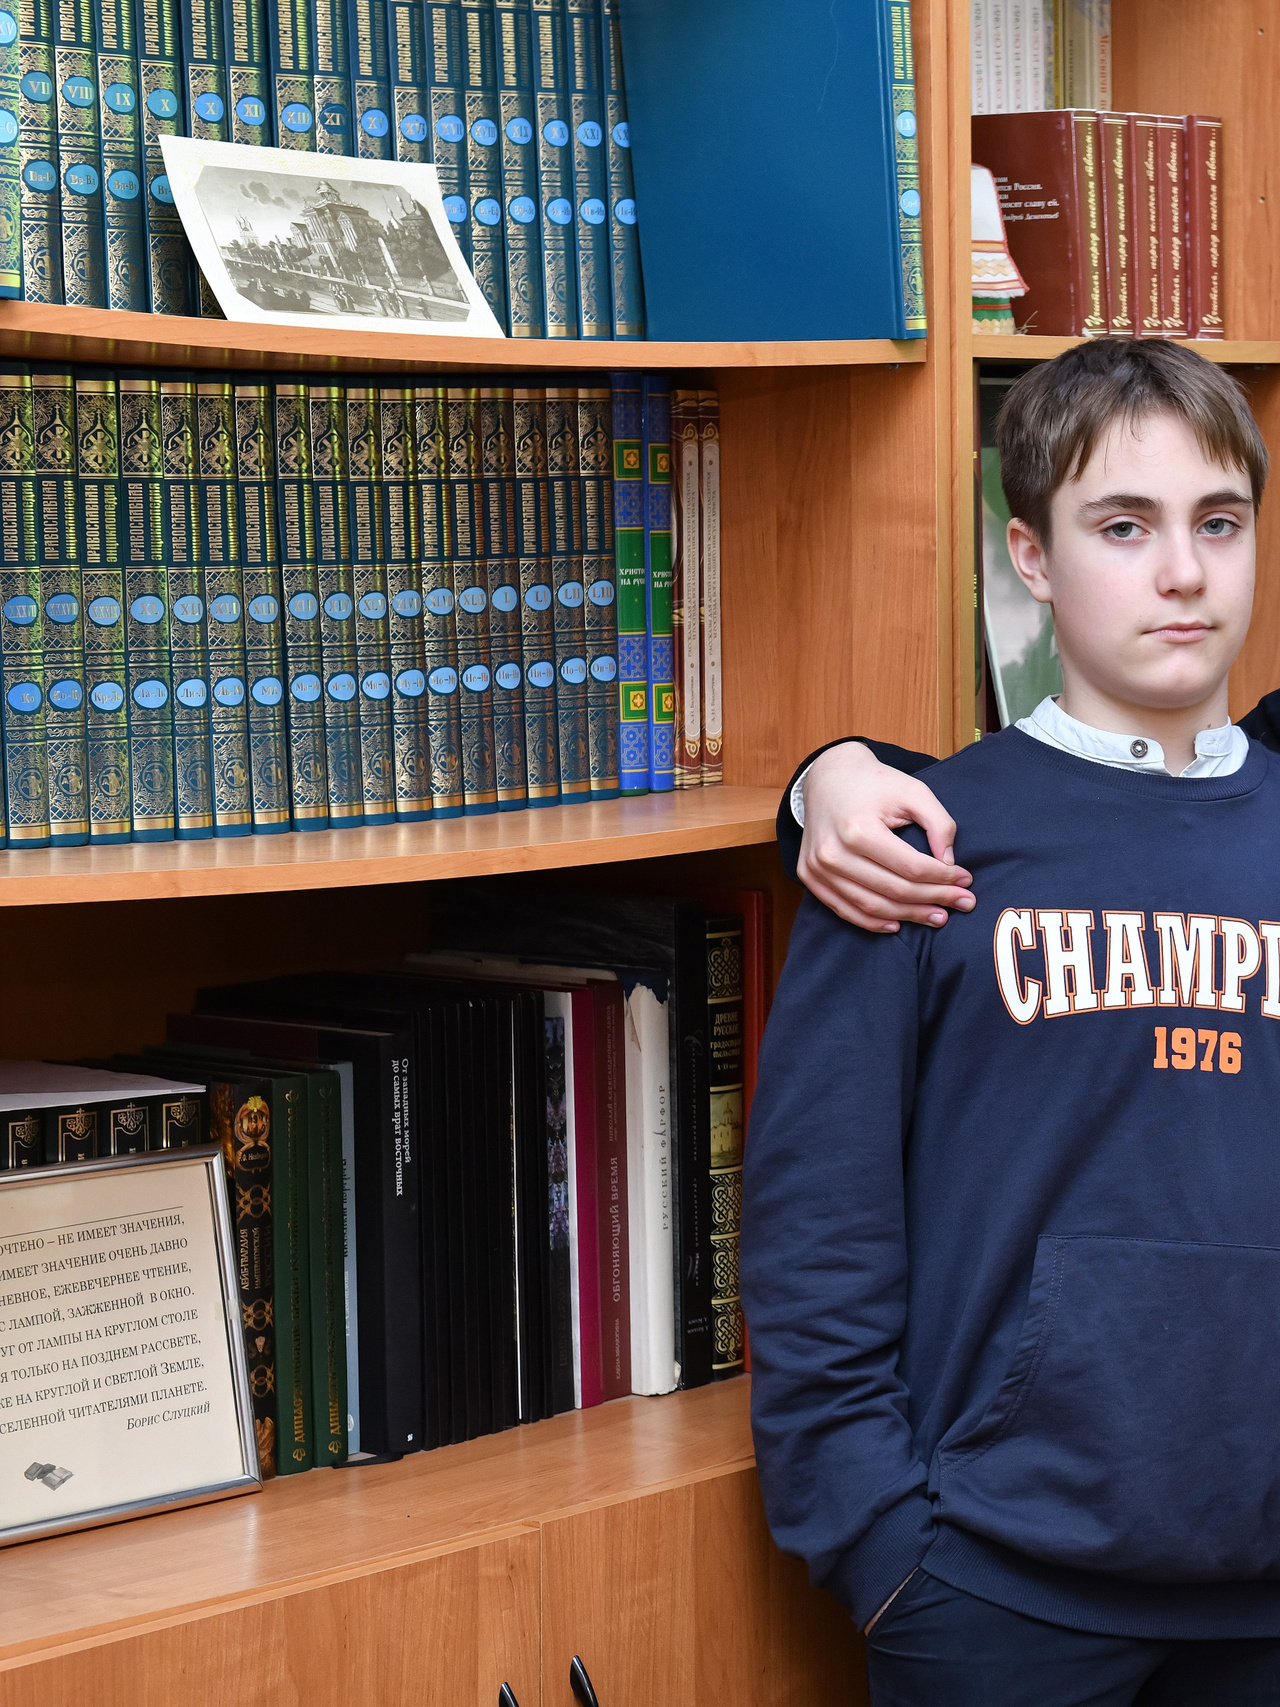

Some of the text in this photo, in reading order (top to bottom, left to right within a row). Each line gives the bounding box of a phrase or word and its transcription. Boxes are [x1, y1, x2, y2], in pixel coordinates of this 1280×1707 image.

[316, 0, 334, 72] ПРАВОСЛАВНА
[396, 6, 413, 83] ПРАВОСЛАВНАЯ
[432, 8, 449, 83] ПРАВОСЛАВНАЯ
[466, 12, 483, 87] ПРАВОСЛАВНАЯ
[501, 12, 518, 87] ПРАВОСЛАВНАЯ
[538, 15, 555, 89] ПРАВОСЛАВНАЯ
[29, 80, 50, 95] VII
[67, 84, 93, 100] VIII
[115, 92, 131, 106] IX
[160, 98, 171, 112] X
[205, 102, 219, 115] XI
[367, 116, 384, 129] XV
[404, 122, 425, 136] XVI
[441, 122, 463, 136] XVII
[512, 125, 530, 139] XIX
[551, 126, 566, 140] XX
[1, 481, 19, 562] ПРАВОСЛАВНАЯ
[42, 480, 60, 560] ПРАВОСЛАВНАЯ
[84, 484, 101, 563] ПРАВОСЛАВНАЯ
[128, 482, 145, 561] ПРАВОСЛАВНАЯ
[169, 484, 188, 562] ПРАВОСЛАВНАЯ
[206, 484, 224, 561] ПРАВОСЛАВНАЯ
[244, 486, 262, 563] ПРАВОСЛАВНАЯ
[284, 484, 301, 560] ПРАВОСЛАВНАЯ
[319, 485, 336, 561] ПРАВОСЛАВНАЯ
[355, 486, 372, 561] ПРАВОСЛАВНАЯ
[388, 485, 406, 560] ПРАВОСЛАВНАЯ
[422, 484, 439, 558] ПРАВОСЛАВНАЯ
[455, 483, 472, 557] ПРАВОСЛАВНАЯ
[488, 482, 504, 555] ПРАВОСЛАВНАЯ
[521, 482, 537, 554] ПРАВОСЛАВНАЯ
[554, 481, 569, 552] ПРАВОСЛАВНАЯ
[585, 480, 600, 550] ПРАВОСЛАВНАЯ
[535, 590, 549, 603] LI
[592, 586, 613, 599] LIII
[620, 578, 631, 586] НА
[140, 603, 158, 616] XL
[391, 1060, 399, 1073] до
[401, 1058, 409, 1073] От
[1153, 1026, 1242, 1074] 1976
[392, 1111, 401, 1135] врат
[403, 1129, 412, 1163] морей
[395, 1138, 403, 1196] восточных
[652, 1085, 669, 1230] РУССКИЙ ФАРФОР
[58, 1233, 74, 1246] НЕ
[77, 1226, 117, 1242] ИМЕЕТ
[119, 1214, 185, 1234] ЗНАЧЕНИЯ,
[609, 1156, 621, 1303] ОБГОНЯЮЩИЙ ВРЕМЯ
[0, 1238, 188, 1282] ИМЕЕТ ЗНАЧЕНИЕ ОЧЕНЬ ДАВНО
[53, 1271, 140, 1297] ЕЖЕВЕЧЕРНЕЕ
[142, 1262, 192, 1280] ЧТЕНИЕ,
[9, 1309, 65, 1331] ЛАМПОЙ,
[67, 1294, 144, 1318] ЗАЖЖЕННОЙ
[150, 1292, 158, 1303] В
[159, 1285, 195, 1301] ОКНО.
[18, 1341, 34, 1354] ОТ
[36, 1332, 82, 1350] ЛАМПЫ
[86, 1328, 102, 1340] НА
[104, 1317, 159, 1337] КРУГЛОМ
[161, 1309, 198, 1325] СТОЛЕ
[0, 1334, 201, 1383] Я ТОЛЬКО НА ПОЗДНЕМ РАССВЕТЕ,
[16, 1393, 33, 1406] НА
[35, 1380, 90, 1402] КРУГЛОЙ
[93, 1377, 102, 1389] И
[104, 1365, 158, 1387] СВЕТЛОЙ
[68, 1393, 148, 1419] ЧИТАТЕЛЯМИ
[151, 1381, 207, 1402] ПЛАНЕТЕ.
